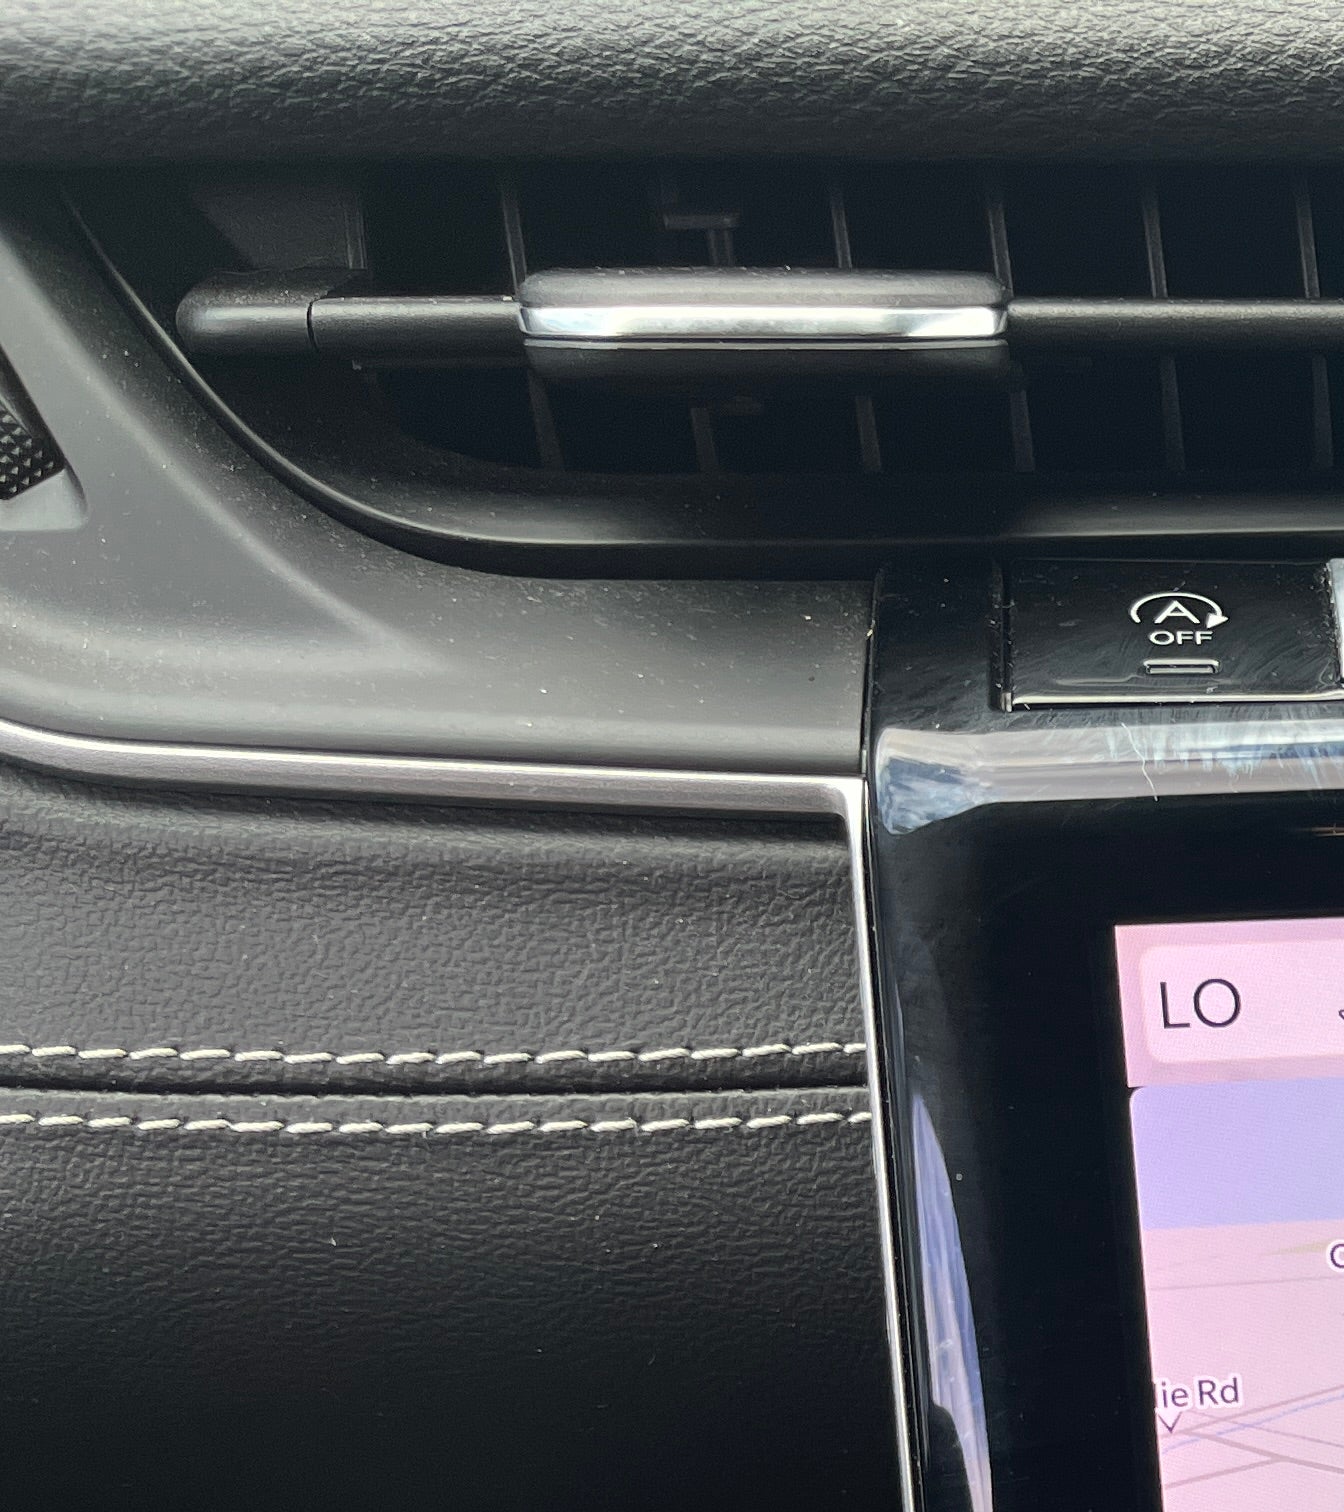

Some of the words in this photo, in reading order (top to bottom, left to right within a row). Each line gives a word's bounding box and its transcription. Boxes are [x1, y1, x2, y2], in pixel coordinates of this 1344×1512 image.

[1148, 631, 1213, 645] OFF
[1159, 977, 1243, 1029] LO
[1198, 1377, 1240, 1405] Rd
